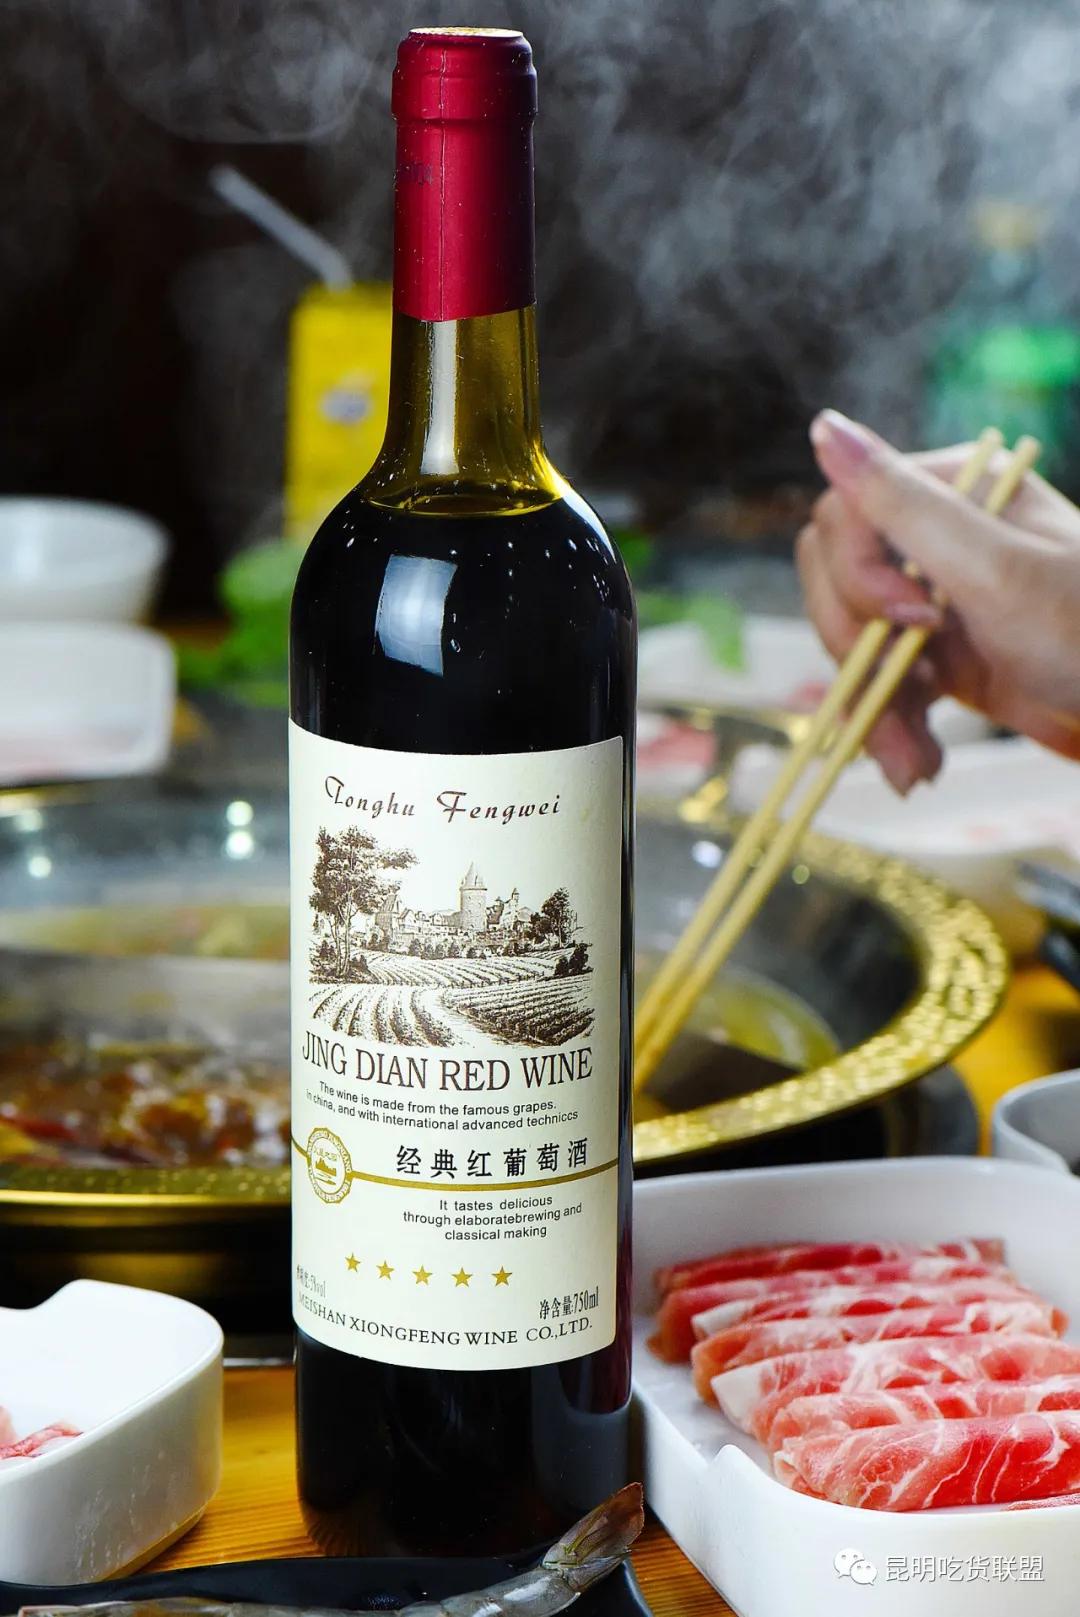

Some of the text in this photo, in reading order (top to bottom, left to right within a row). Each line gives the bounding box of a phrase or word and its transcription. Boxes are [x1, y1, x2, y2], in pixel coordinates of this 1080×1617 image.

[436, 791, 561, 825] Fengwei
[302, 1030, 593, 1091] JING DIAN RED WINE
[306, 1088, 312, 1100] in
[313, 1093, 336, 1113] china,
[338, 1104, 356, 1117] and
[358, 1108, 380, 1122] with
[382, 1112, 459, 1131] international
[462, 1117, 523, 1131] advanced
[319, 1081, 557, 1117] The wine is made from the famous grapes.
[396, 1137, 589, 1179] 经典红葡萄酒
[403, 1203, 583, 1228] through elaboratebrewing and
[440, 1196, 553, 1211] It tastes delicious
[445, 1226, 547, 1241] classical making
[349, 1316, 460, 1345] XIONGFENG
[464, 1330, 518, 1346] WINE
